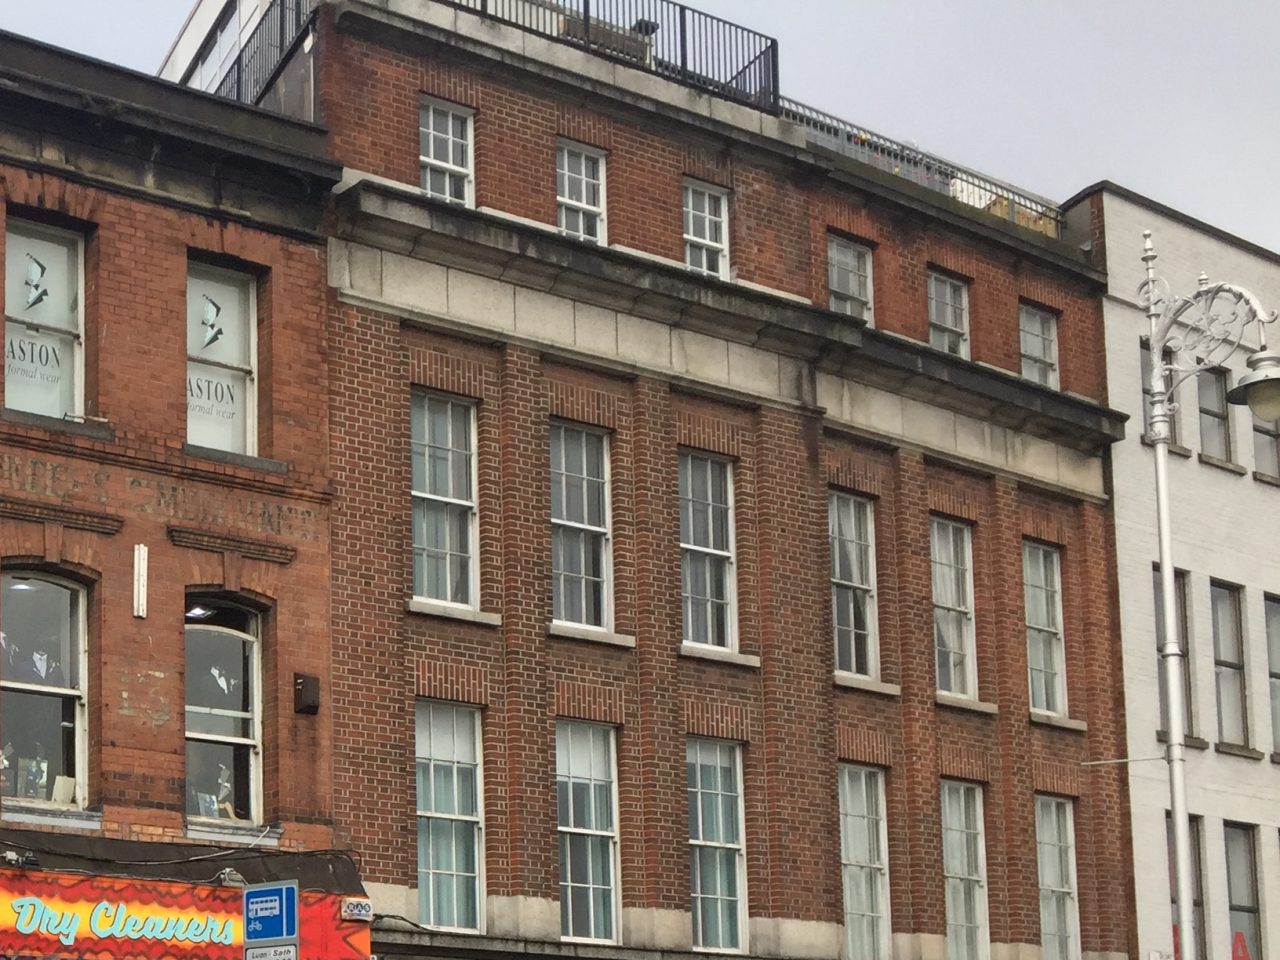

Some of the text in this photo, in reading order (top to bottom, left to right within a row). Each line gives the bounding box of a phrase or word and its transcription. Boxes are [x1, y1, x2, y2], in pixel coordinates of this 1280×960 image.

[6, 337, 61, 368] ASTON
[6, 363, 62, 385] formal wear
[11, 896, 234, 946] Dry Cleaners
